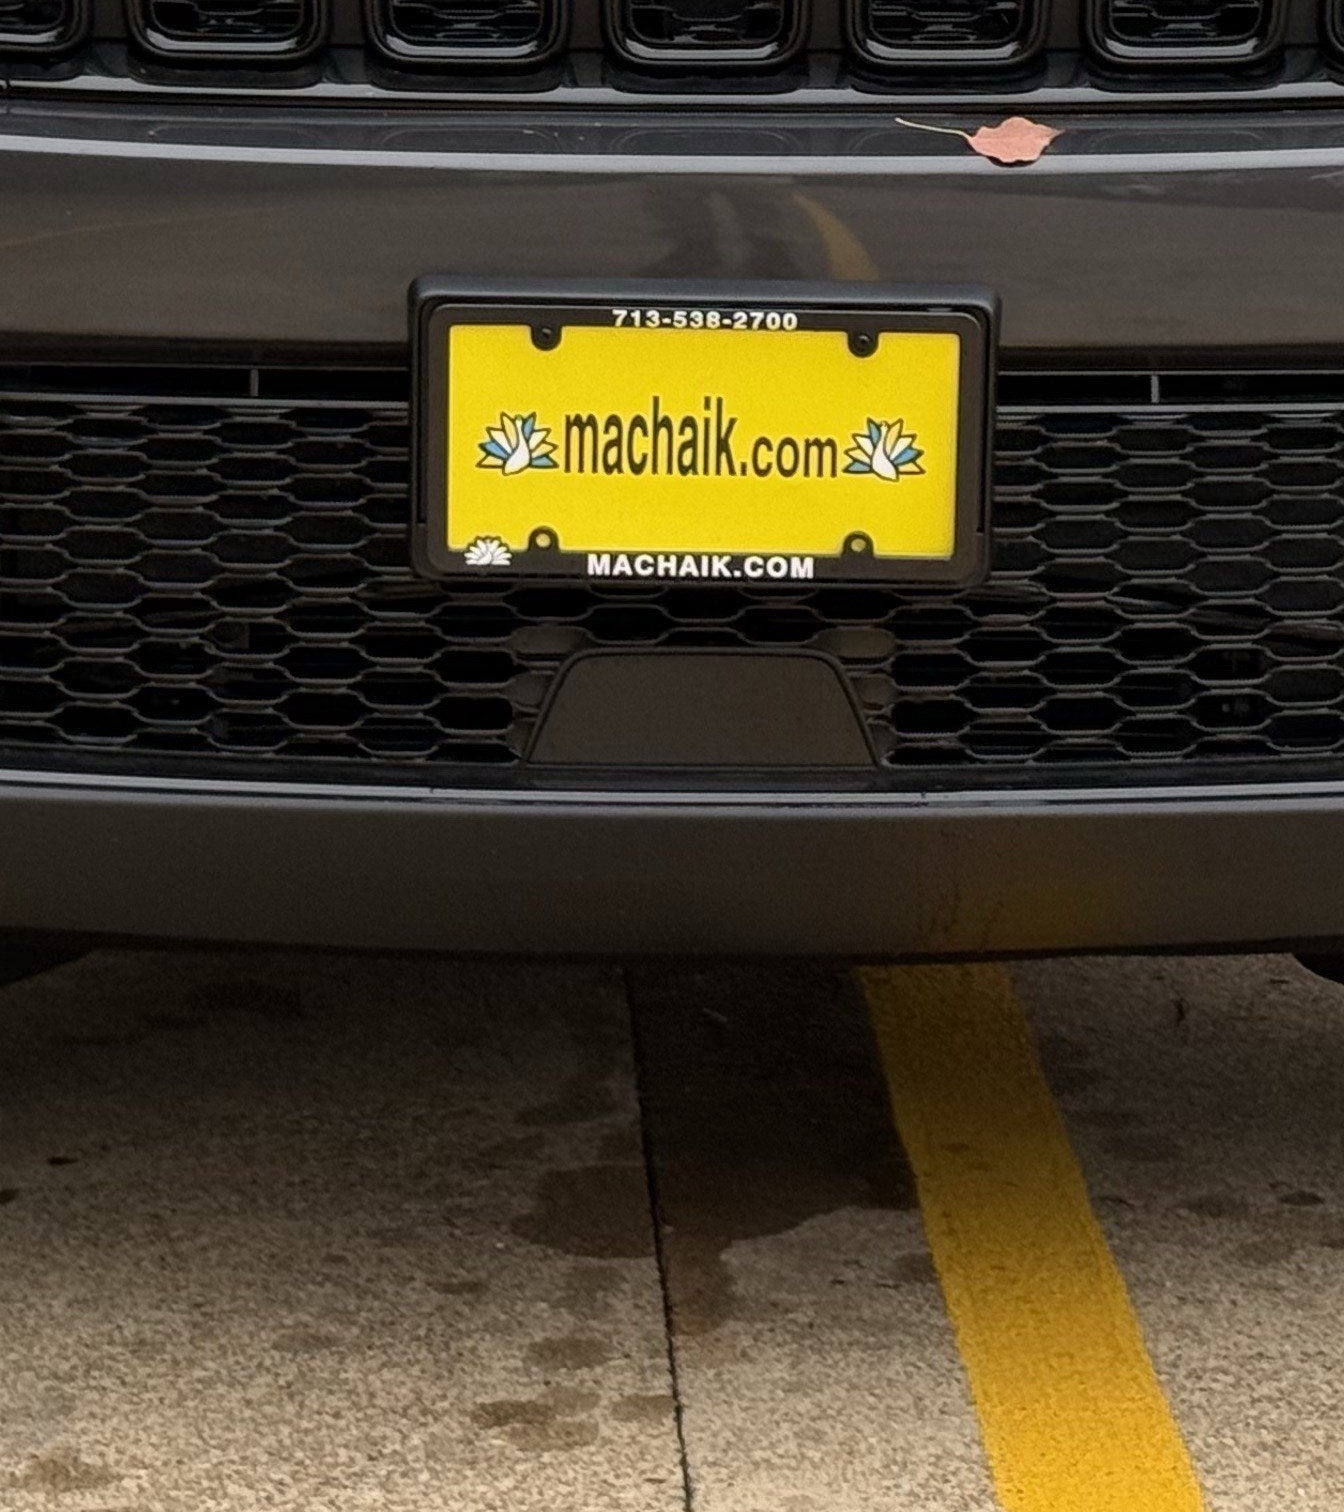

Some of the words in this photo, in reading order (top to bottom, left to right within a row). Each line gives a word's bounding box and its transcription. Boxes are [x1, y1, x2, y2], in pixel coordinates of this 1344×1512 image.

[612, 309, 798, 330] 713-538-2700
[563, 396, 838, 478] machaik.com
[587, 553, 814, 580] MACHAIK.COM
